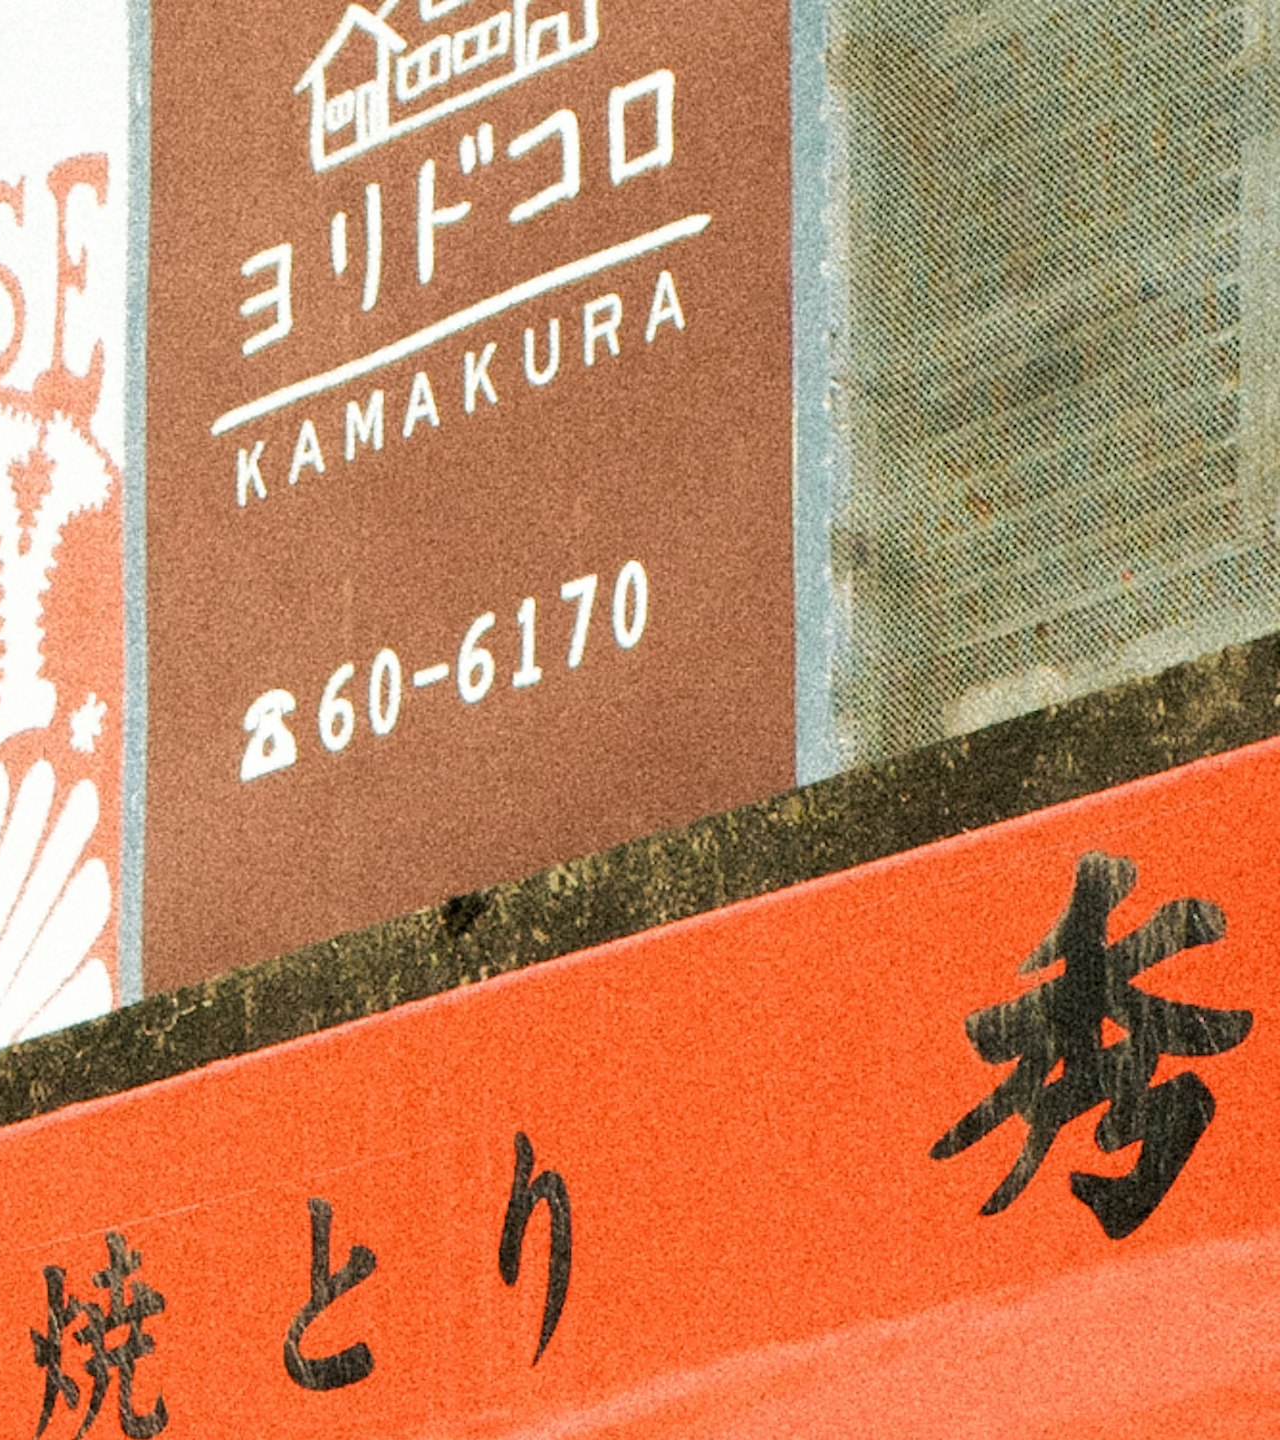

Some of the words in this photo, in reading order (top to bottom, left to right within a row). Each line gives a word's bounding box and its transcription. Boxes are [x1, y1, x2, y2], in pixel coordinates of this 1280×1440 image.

[238, 68, 676, 356] ヨリドコロ
[233, 269, 690, 507] KAMAKURA
[316, 560, 651, 753] 60-6170
[928, 851, 1255, 1240] 秀
